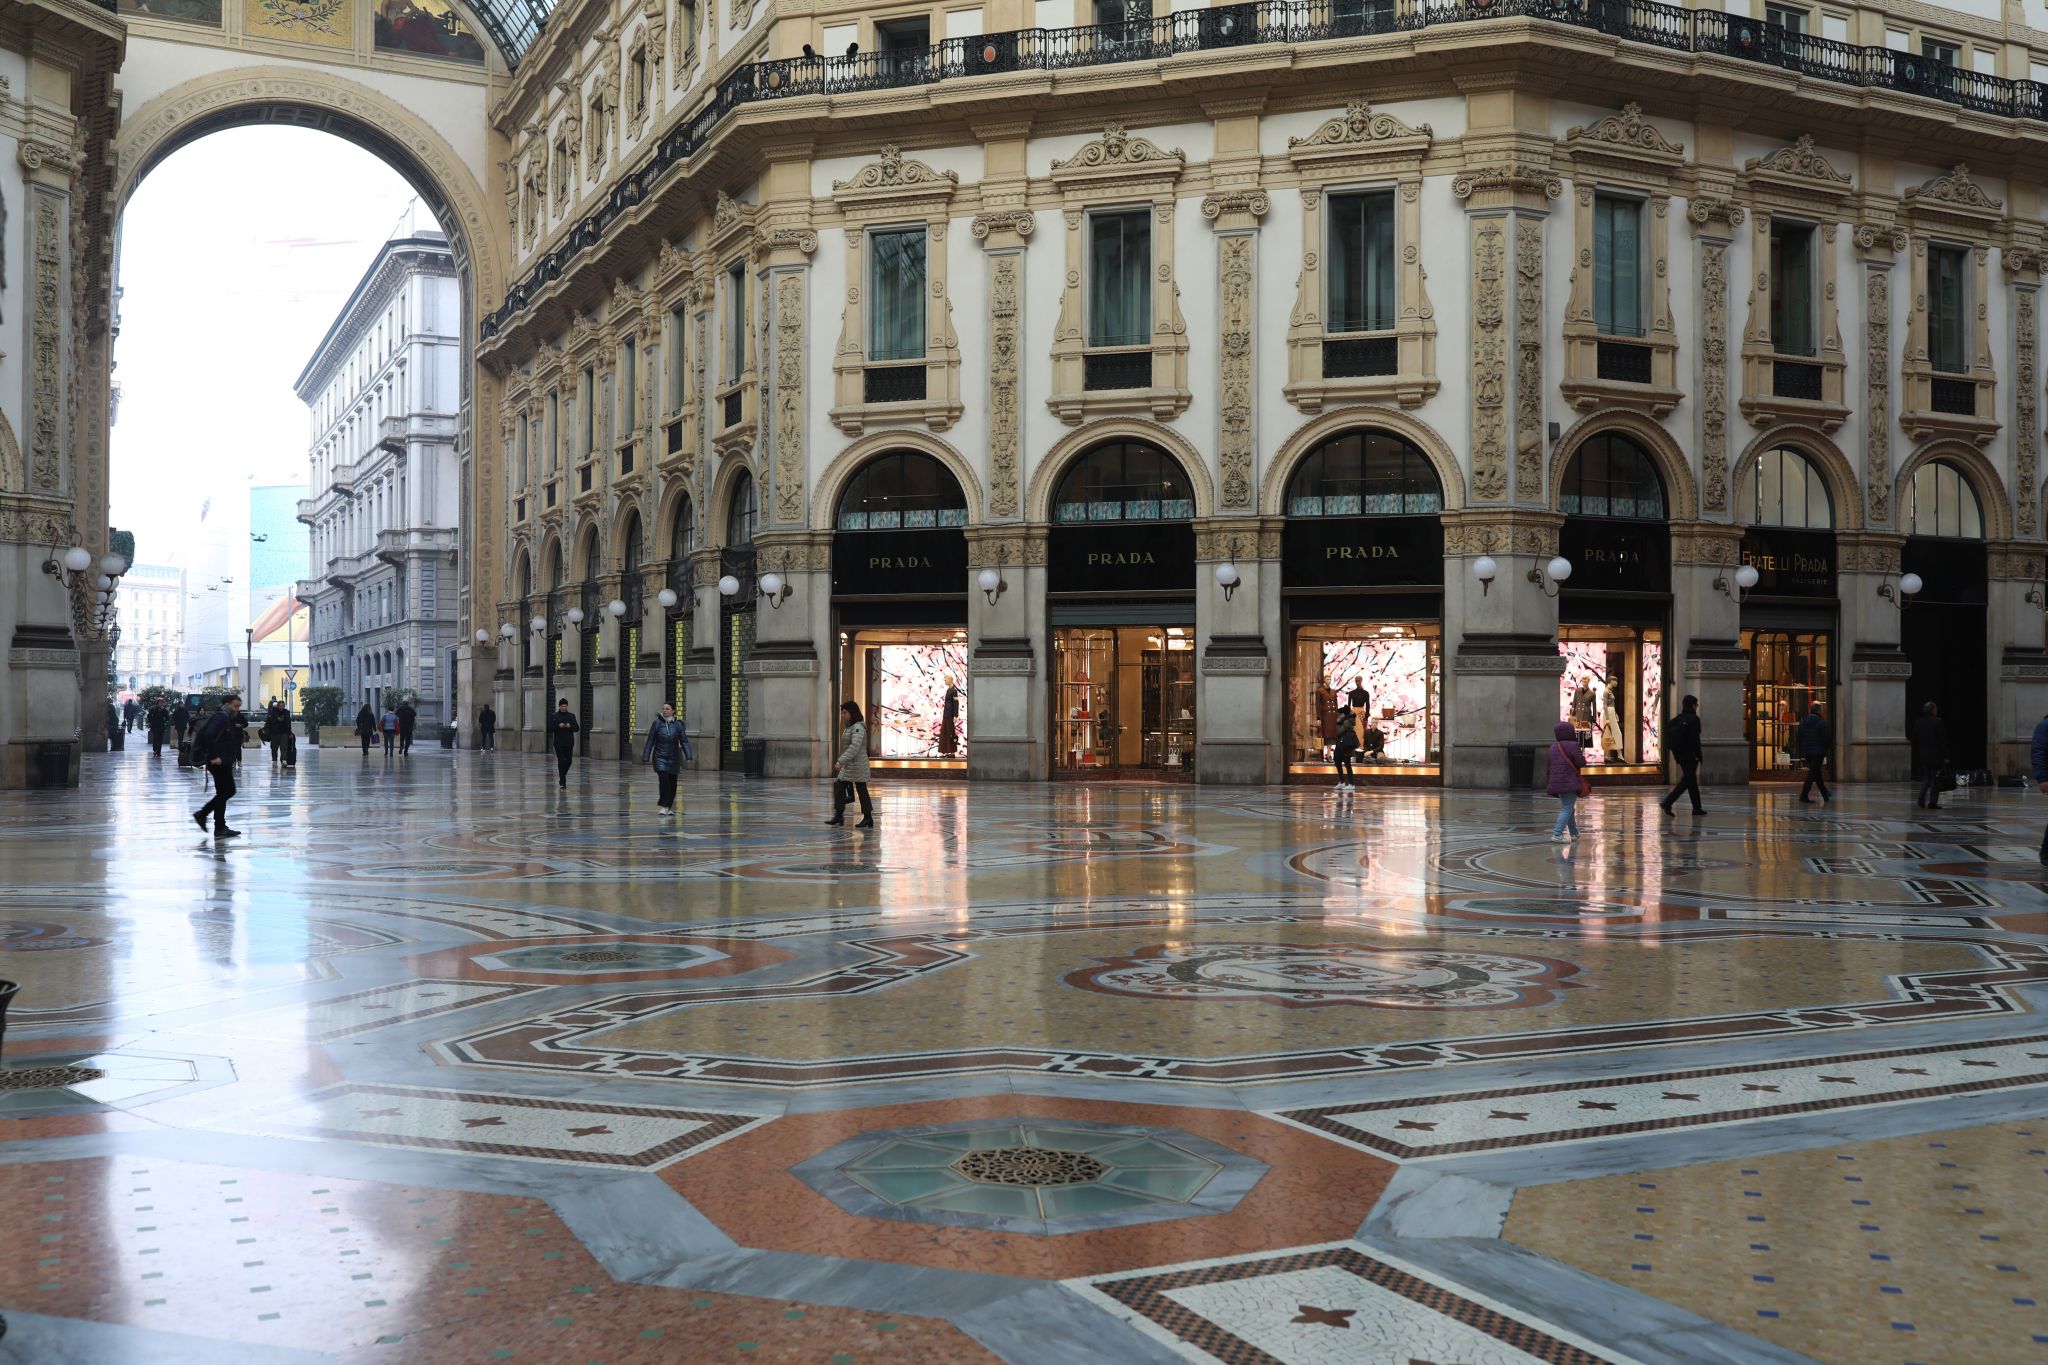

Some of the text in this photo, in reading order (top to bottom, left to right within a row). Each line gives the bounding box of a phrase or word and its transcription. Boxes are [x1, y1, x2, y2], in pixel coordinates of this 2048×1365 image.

[1087, 551, 1156, 565] PRADA
[1326, 545, 1400, 559] PRADA
[1584, 549, 1639, 562] PRADA
[869, 556, 932, 569] PRADA
[1742, 550, 1828, 573] FRATELLI PRADA
